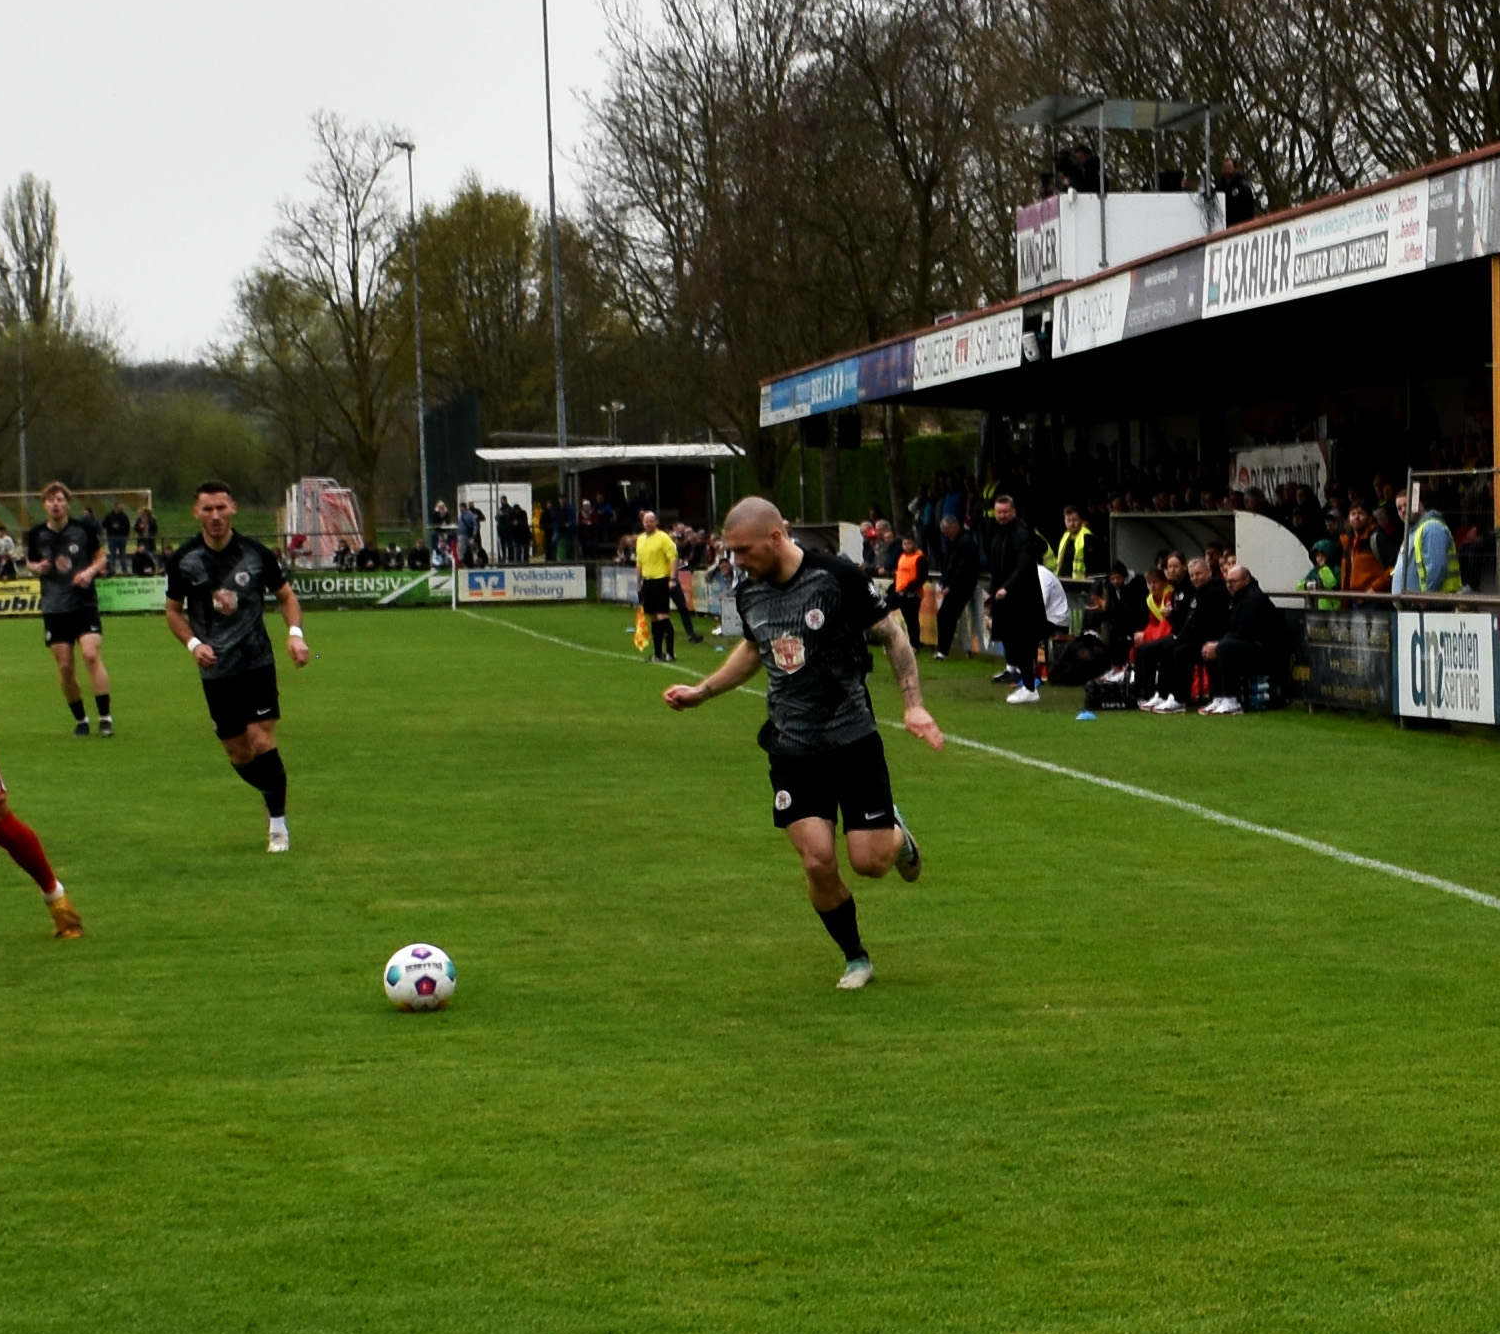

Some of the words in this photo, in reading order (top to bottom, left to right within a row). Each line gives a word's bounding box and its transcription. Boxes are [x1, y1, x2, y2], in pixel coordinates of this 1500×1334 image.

[1019, 227, 1058, 285] KINDLER
[1223, 228, 1292, 306] SEXAUER
[512, 583, 565, 598] Freiburg
[513, 569, 575, 583] Volksbank
[1442, 620, 1480, 671] medien
[1444, 670, 1480, 712] service
